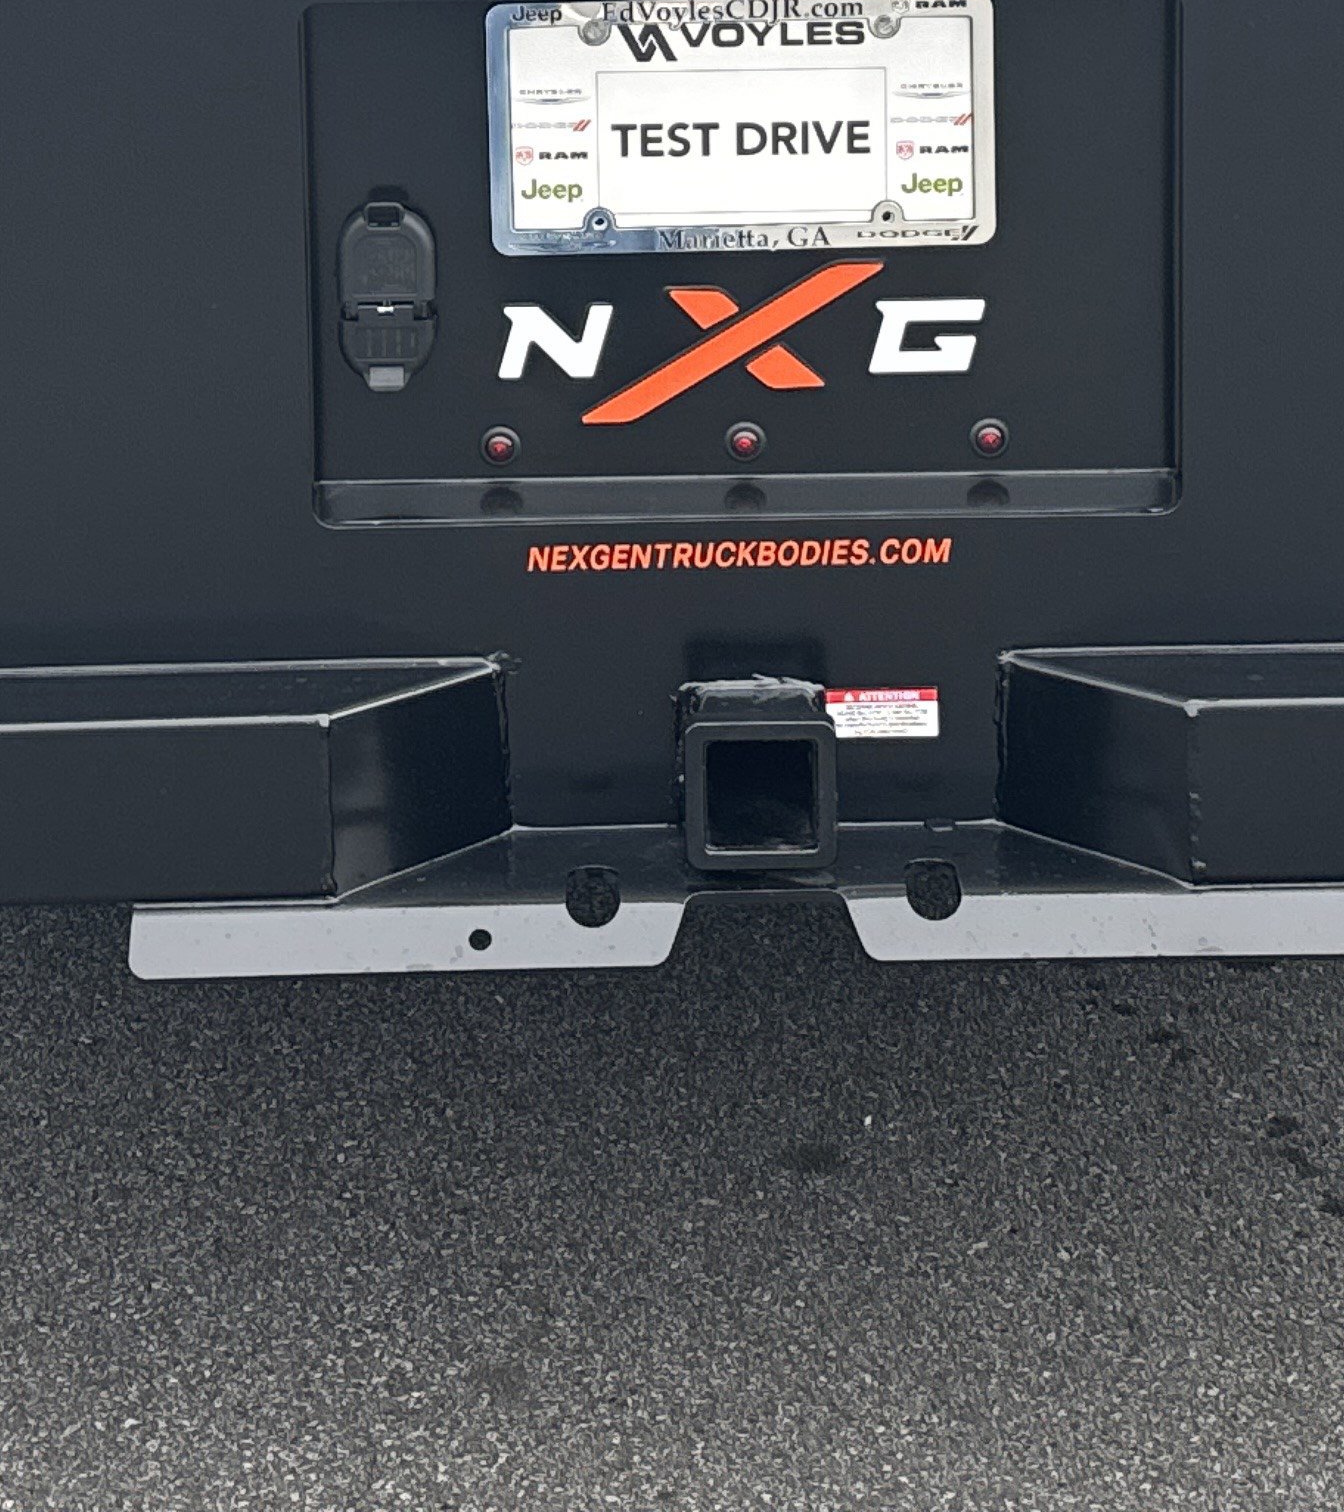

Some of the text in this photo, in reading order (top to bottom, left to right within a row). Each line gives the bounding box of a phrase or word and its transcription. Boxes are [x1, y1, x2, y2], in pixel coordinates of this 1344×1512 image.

[512, 6, 562, 25] Jeep
[915, 0, 968, 9] RAM
[680, 20, 865, 48] VOYLES
[610, 120, 871, 158] TEST DRIVE
[919, 145, 970, 154] RAM
[538, 151, 589, 160] RAM
[521, 178, 583, 203] Jeep
[901, 172, 964, 197] Jeep
[786, 225, 832, 248] GA
[526, 537, 953, 573] NEXGENTRUCKBODIES.COM
[858, 689, 921, 702] ATTENTION
